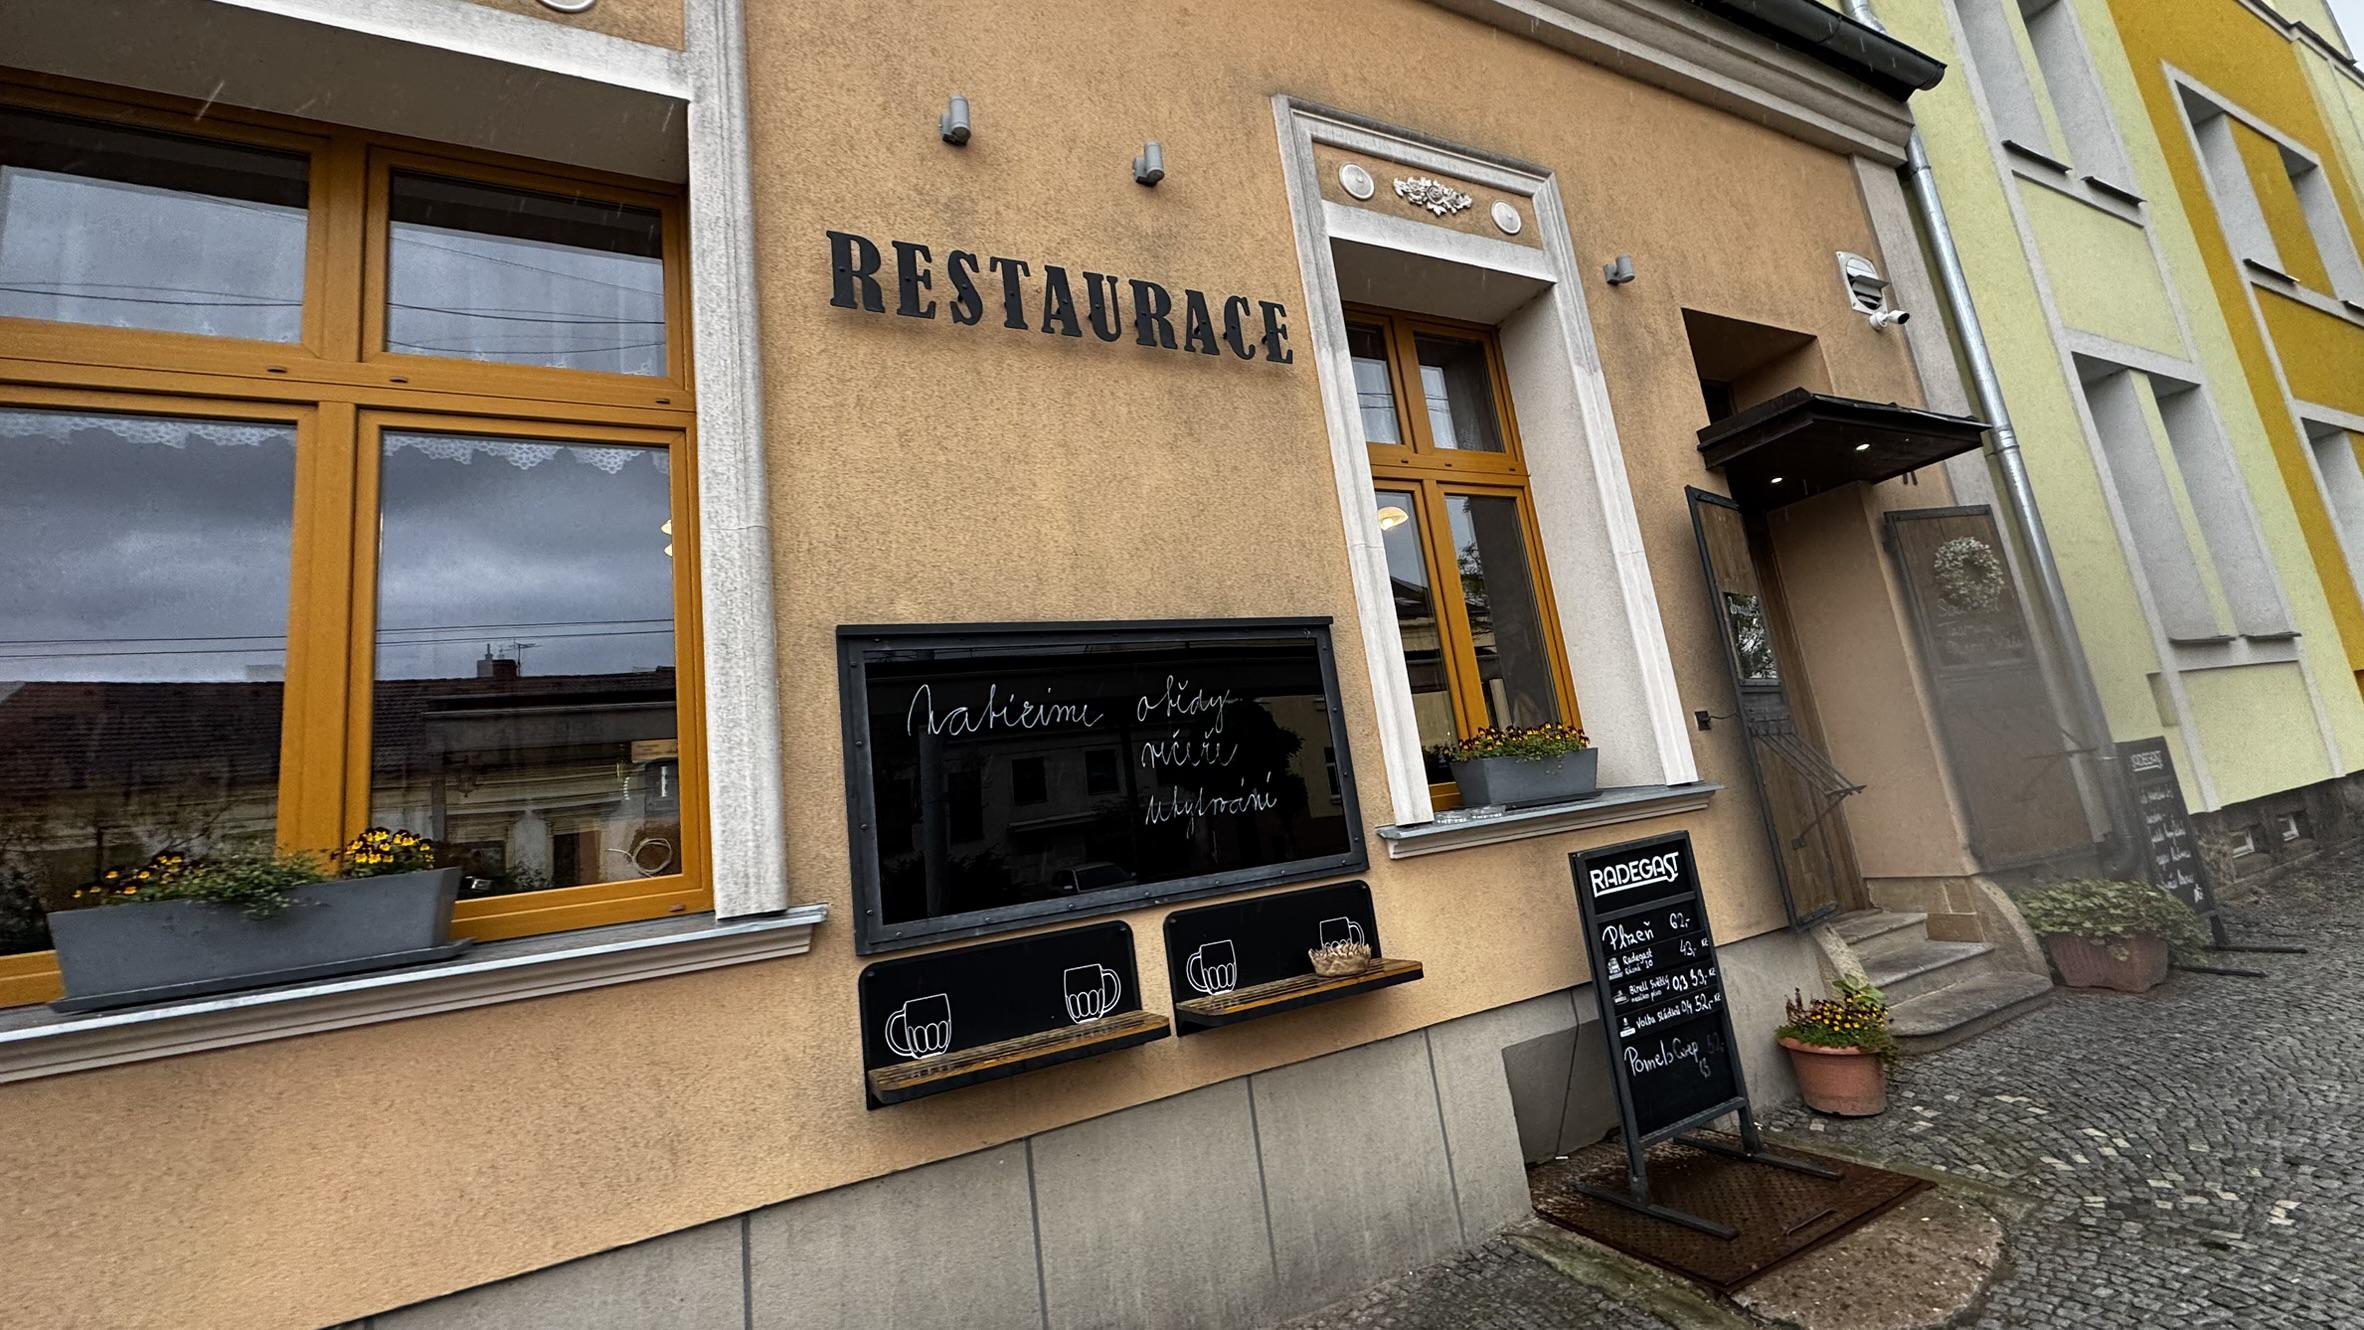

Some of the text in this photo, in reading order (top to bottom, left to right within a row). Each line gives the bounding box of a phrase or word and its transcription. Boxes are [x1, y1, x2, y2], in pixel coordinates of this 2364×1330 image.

[826, 230, 1294, 365] RESTAURACE
[1590, 851, 1679, 897] RADEGAST
[1602, 921, 1654, 950] Plzeň
